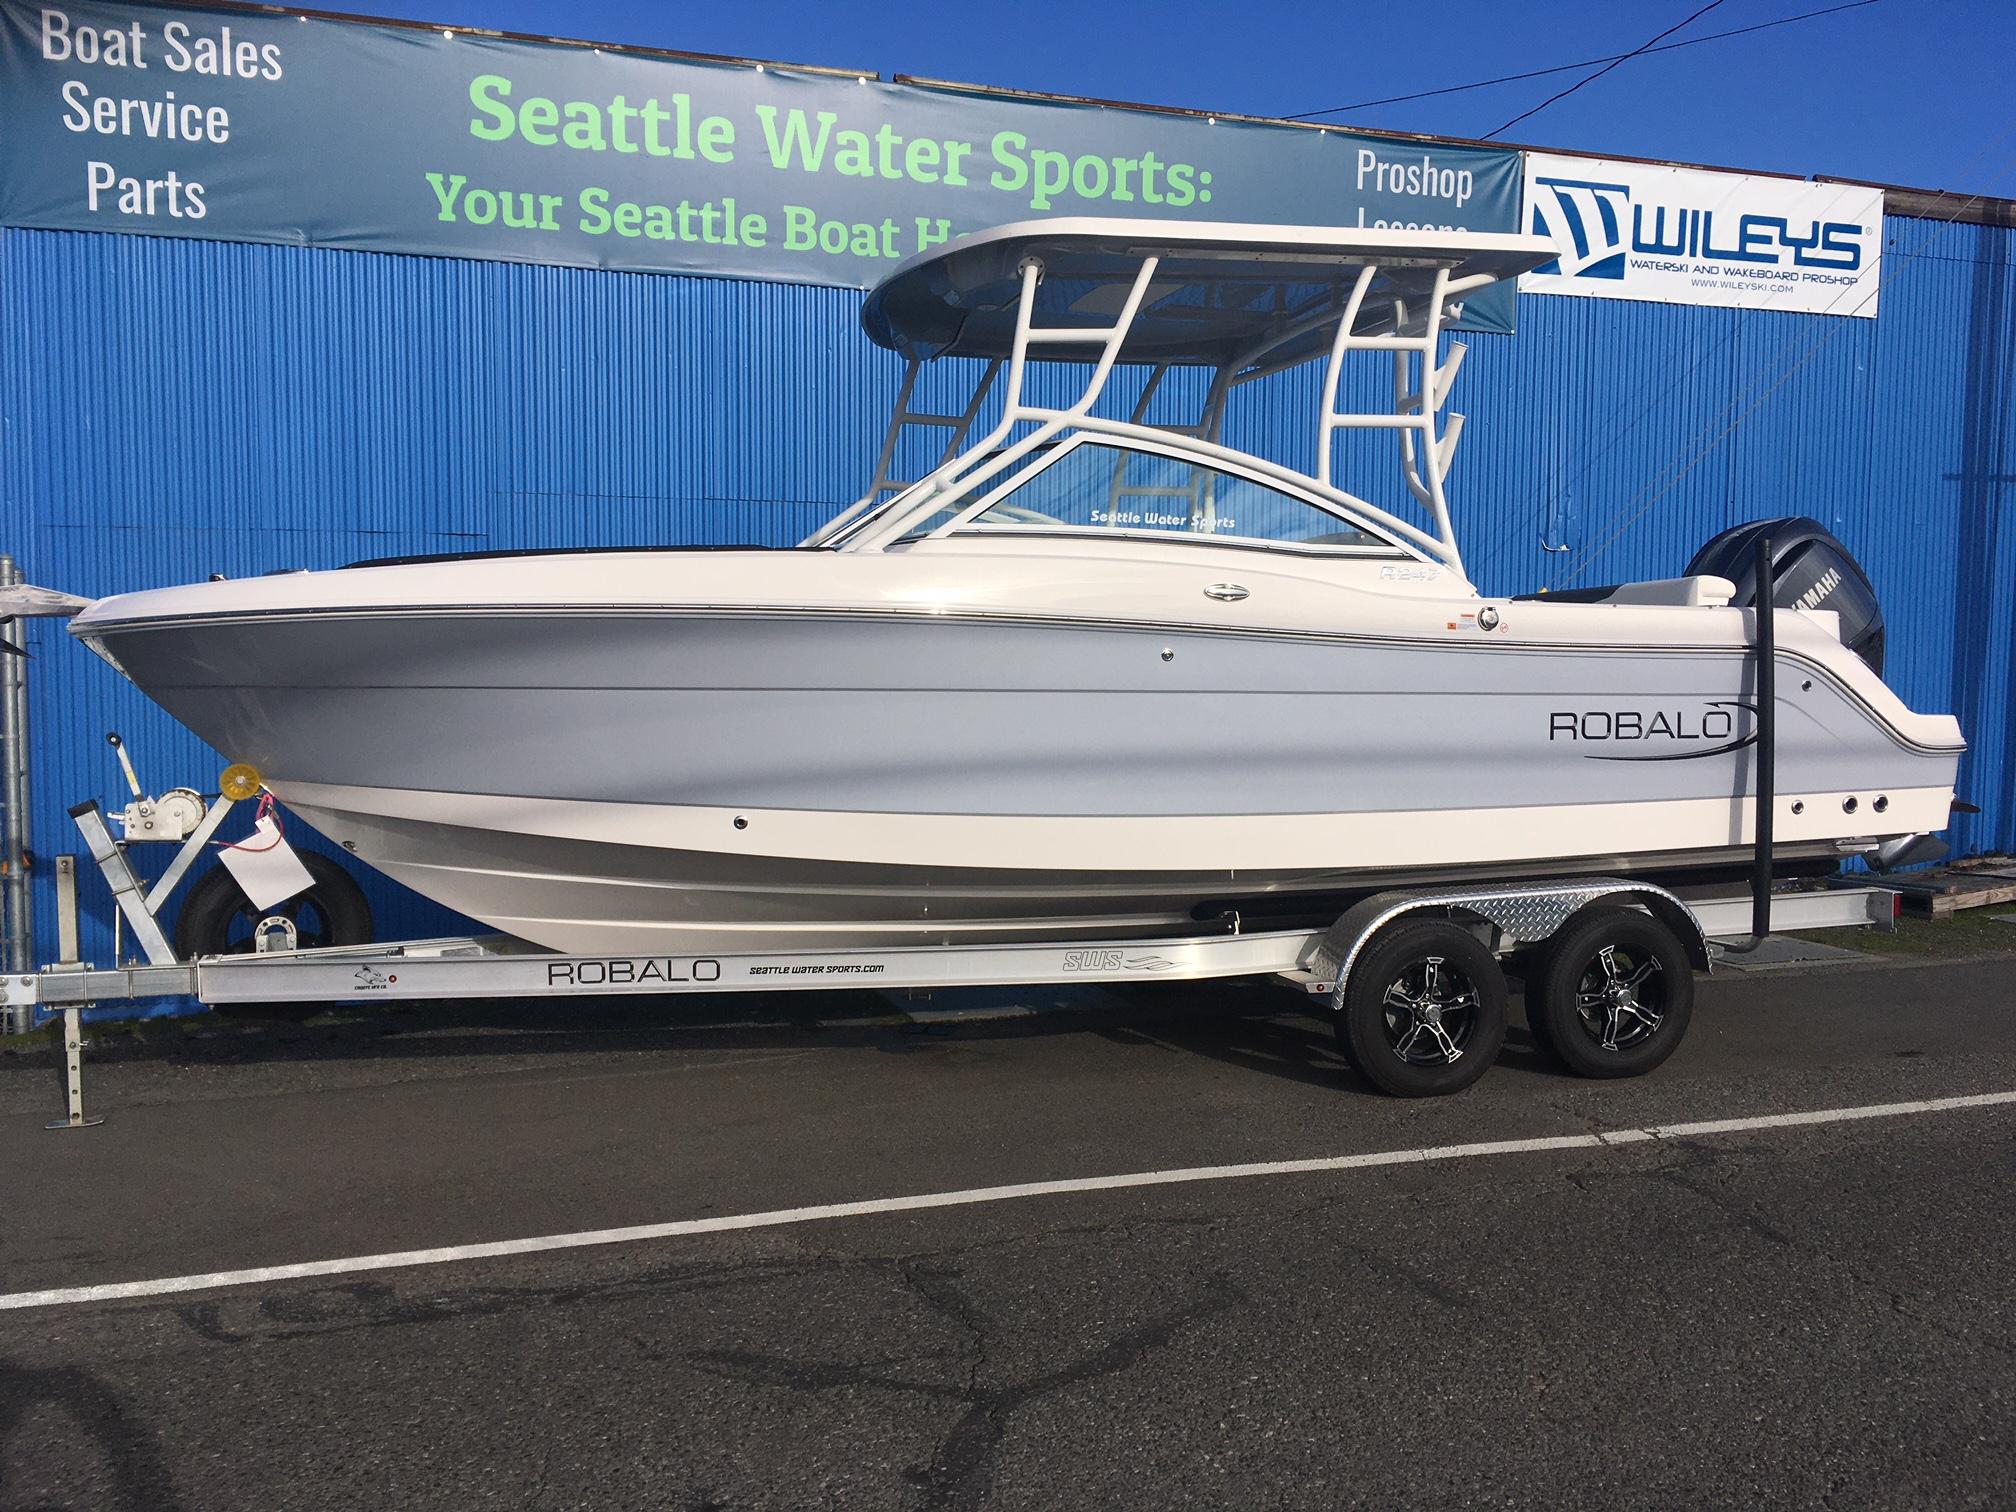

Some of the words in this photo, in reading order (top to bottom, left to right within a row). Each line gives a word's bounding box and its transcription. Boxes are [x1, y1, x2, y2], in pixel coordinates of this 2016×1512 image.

[41, 9, 148, 69] Boat
[163, 21, 283, 81] Sales
[62, 80, 230, 144] Service
[469, 74, 736, 163] Seattle
[755, 104, 972, 186] Water
[990, 130, 1213, 211] Sports:
[87, 160, 207, 219] Parts
[1357, 149, 1473, 208] Proshop
[425, 172, 563, 231] Your
[578, 187, 768, 248] Seattle
[783, 205, 901, 258] Boat
[1632, 204, 1863, 271] WILEYS
[1630, 260, 1689, 273] WATERSKI
[1693, 265, 1719, 275] AND
[1723, 267, 1799, 282] WAKEBOARD
[1802, 273, 1858, 286] PROSHOP
[1691, 278, 1794, 294] WWW.WILEYSKI.COM
[1090, 510, 1141, 524] Seattle
[1144, 512, 1187, 526] Water
[1191, 514, 1235, 530] Sports
[1549, 711, 1731, 740] ROBALO
[547, 959, 721, 986] ROBALO
[1063, 950, 1123, 972] SWS
